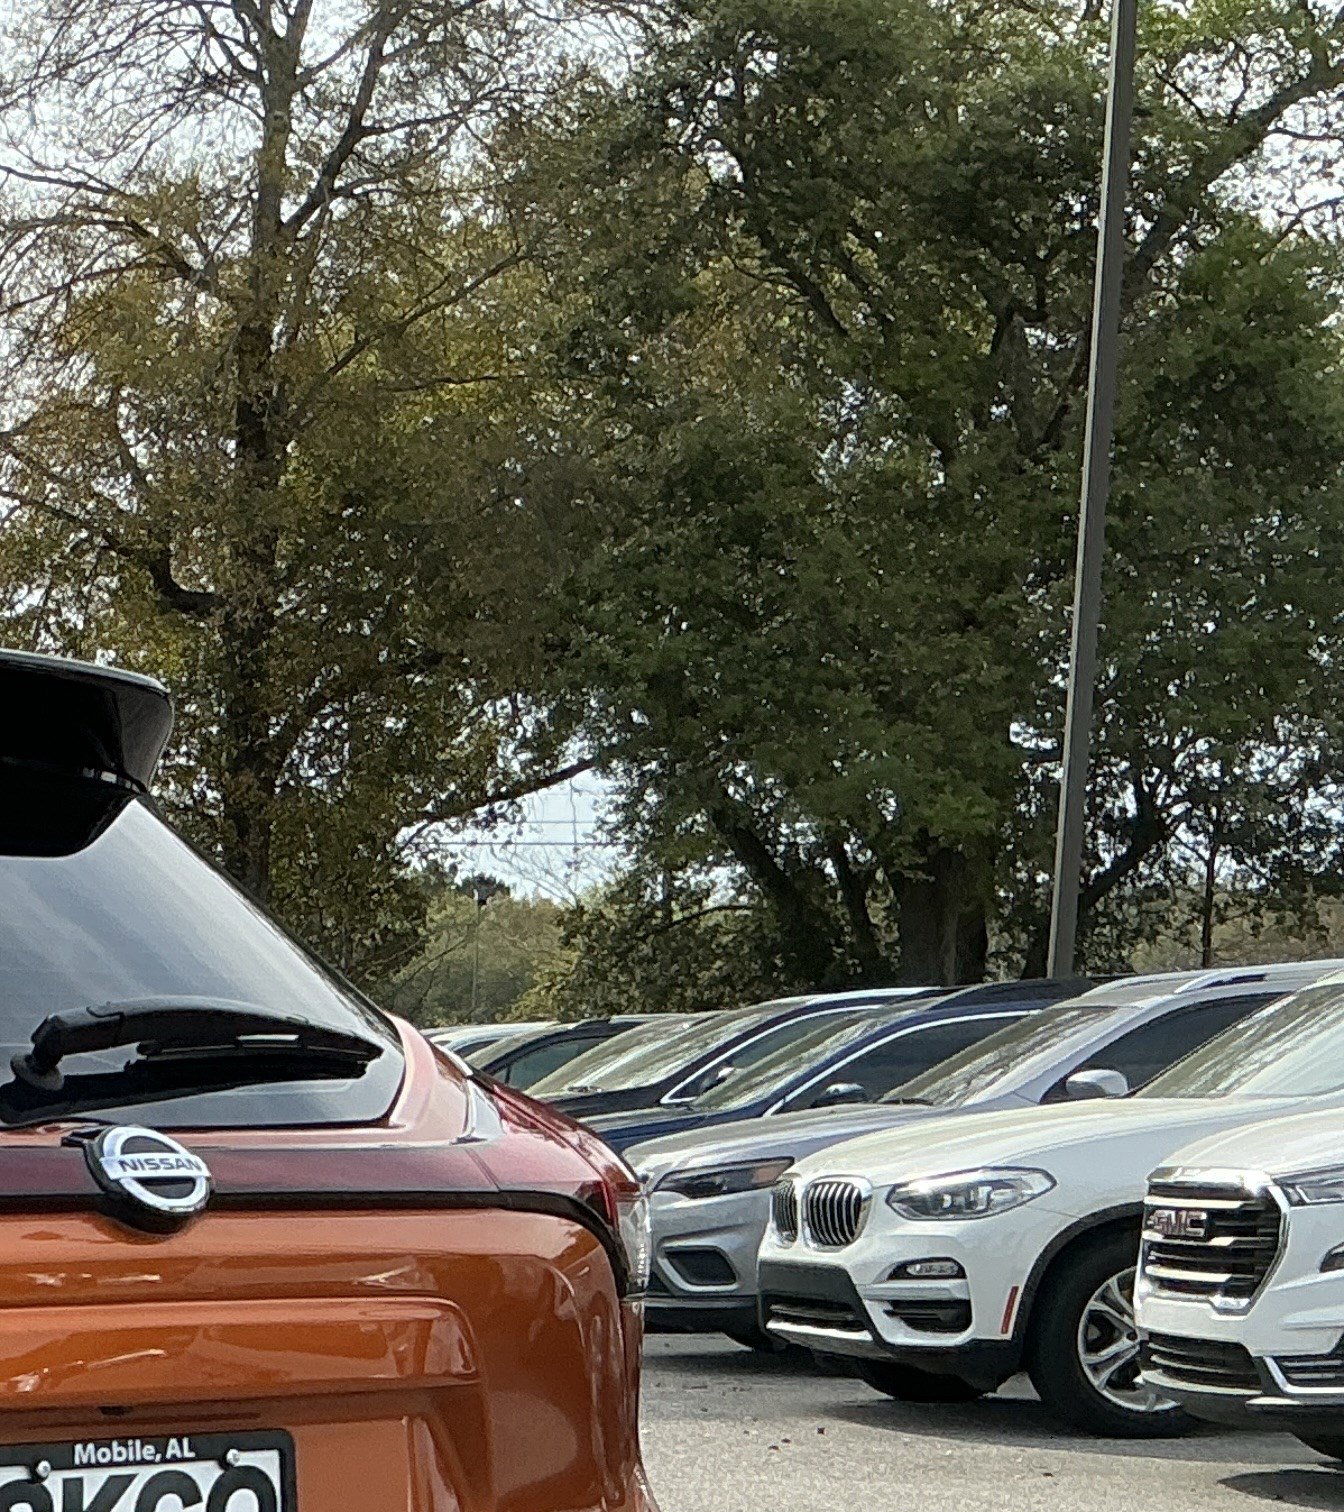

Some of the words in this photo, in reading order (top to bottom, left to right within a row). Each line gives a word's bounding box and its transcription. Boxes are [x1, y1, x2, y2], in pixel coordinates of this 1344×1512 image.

[118, 1157, 202, 1172] NISSAN
[73, 1440, 161, 1467] Mobile,
[165, 1437, 196, 1460] AL
